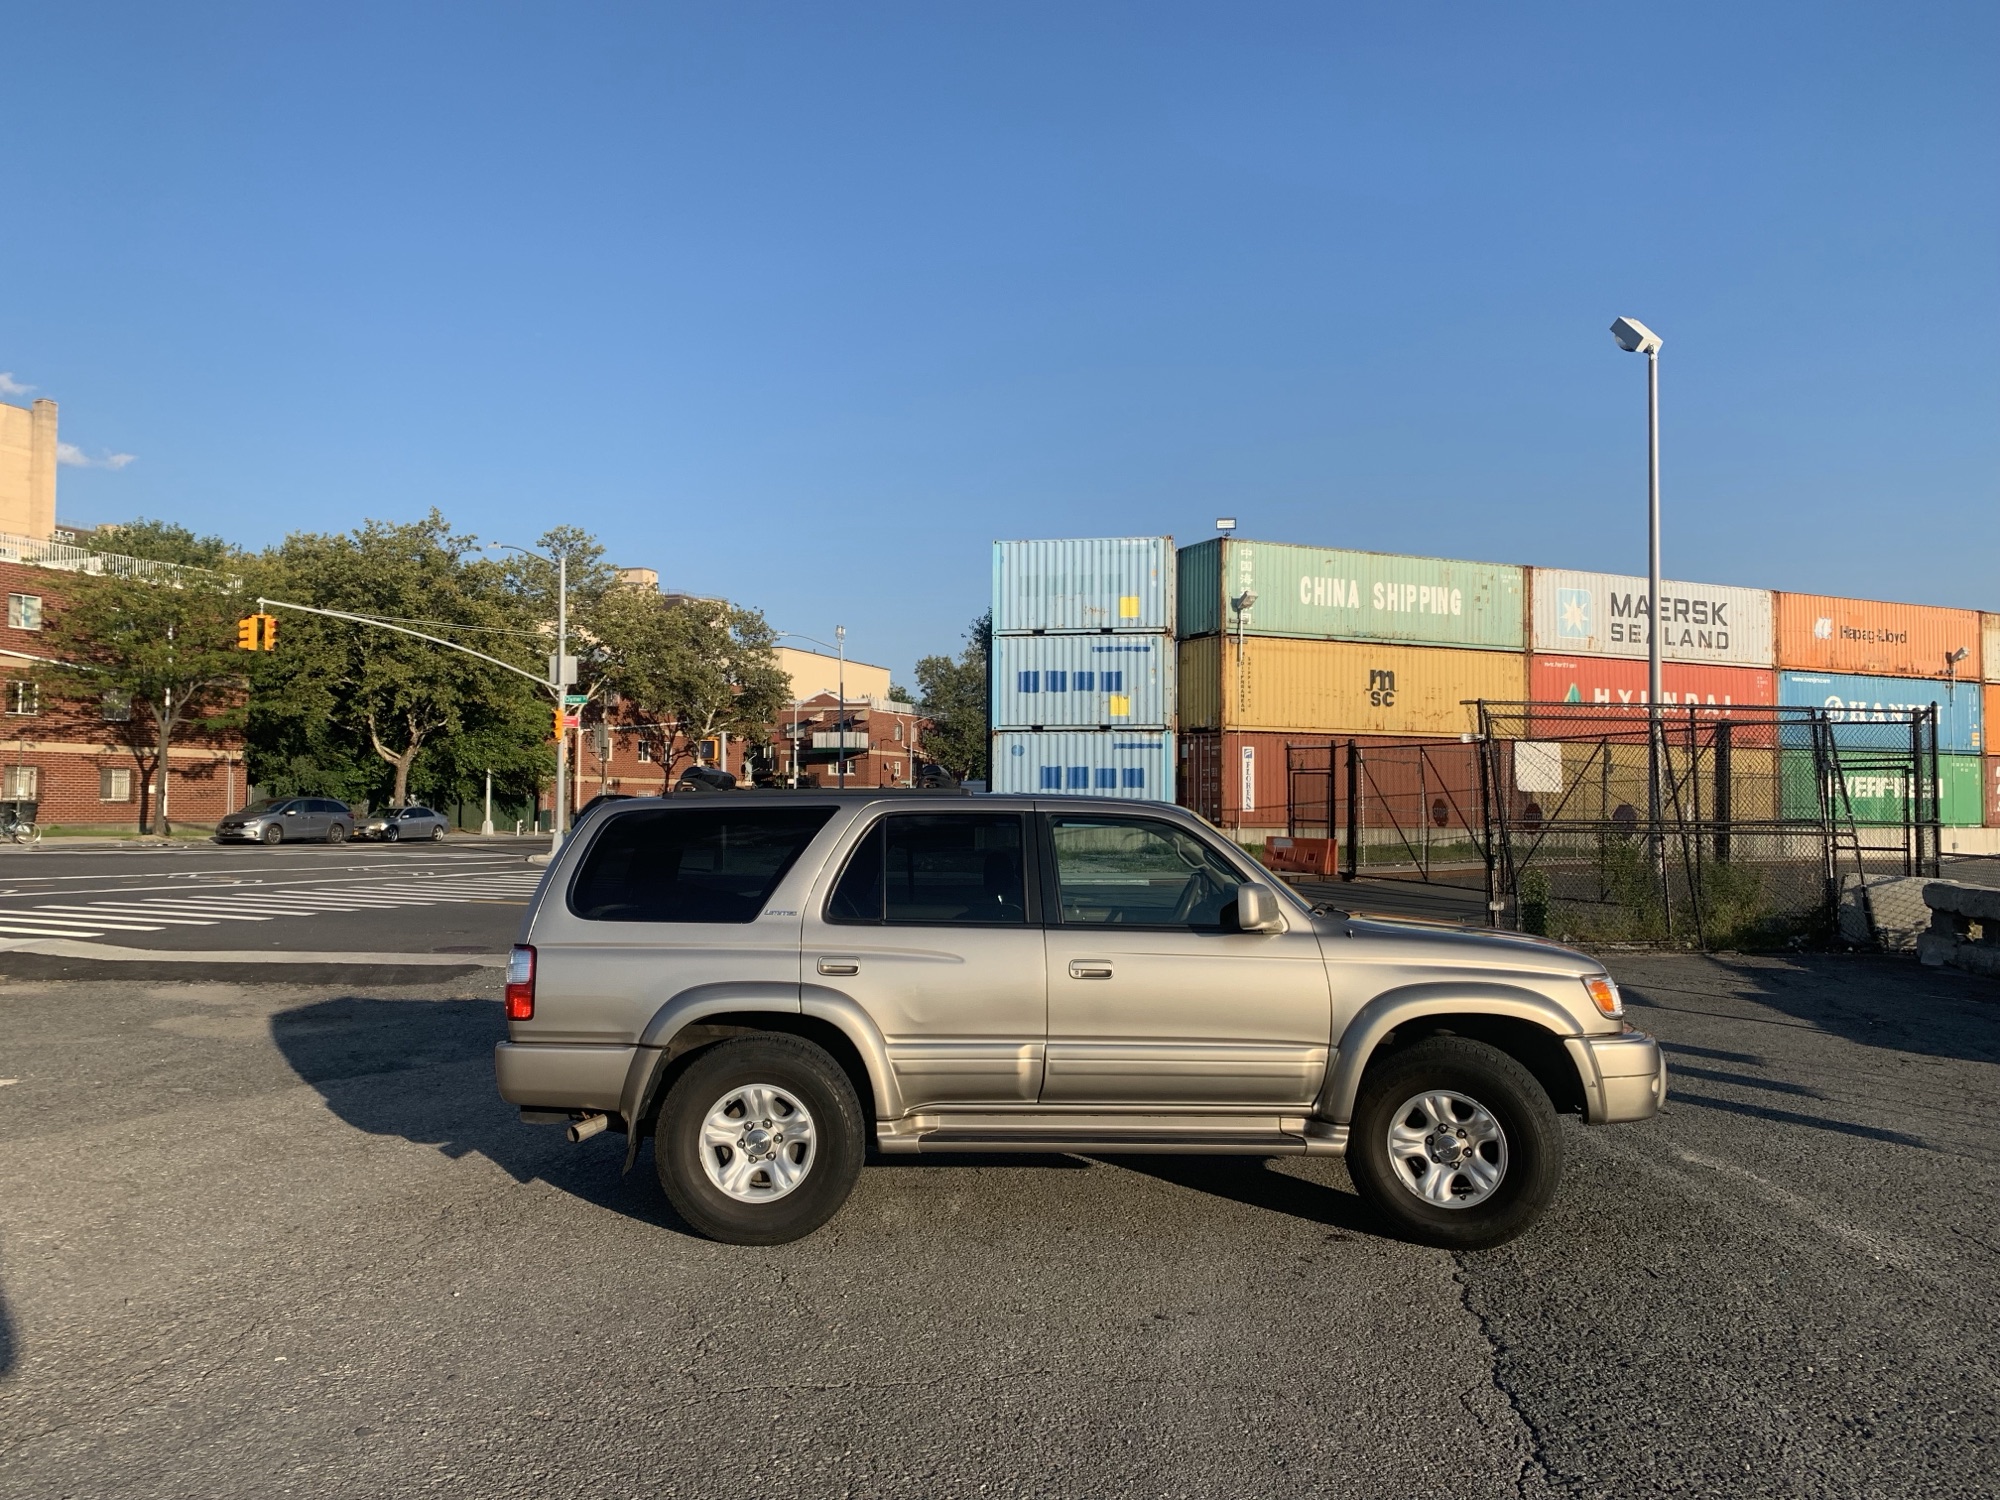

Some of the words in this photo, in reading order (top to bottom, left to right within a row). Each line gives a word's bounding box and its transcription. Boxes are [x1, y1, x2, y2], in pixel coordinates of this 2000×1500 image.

[1300, 576, 1360, 609] CHINA
[1373, 581, 1462, 616] SHIPPING
[1610, 592, 1729, 627] MAERSK
[1610, 622, 1730, 650] SELAND
